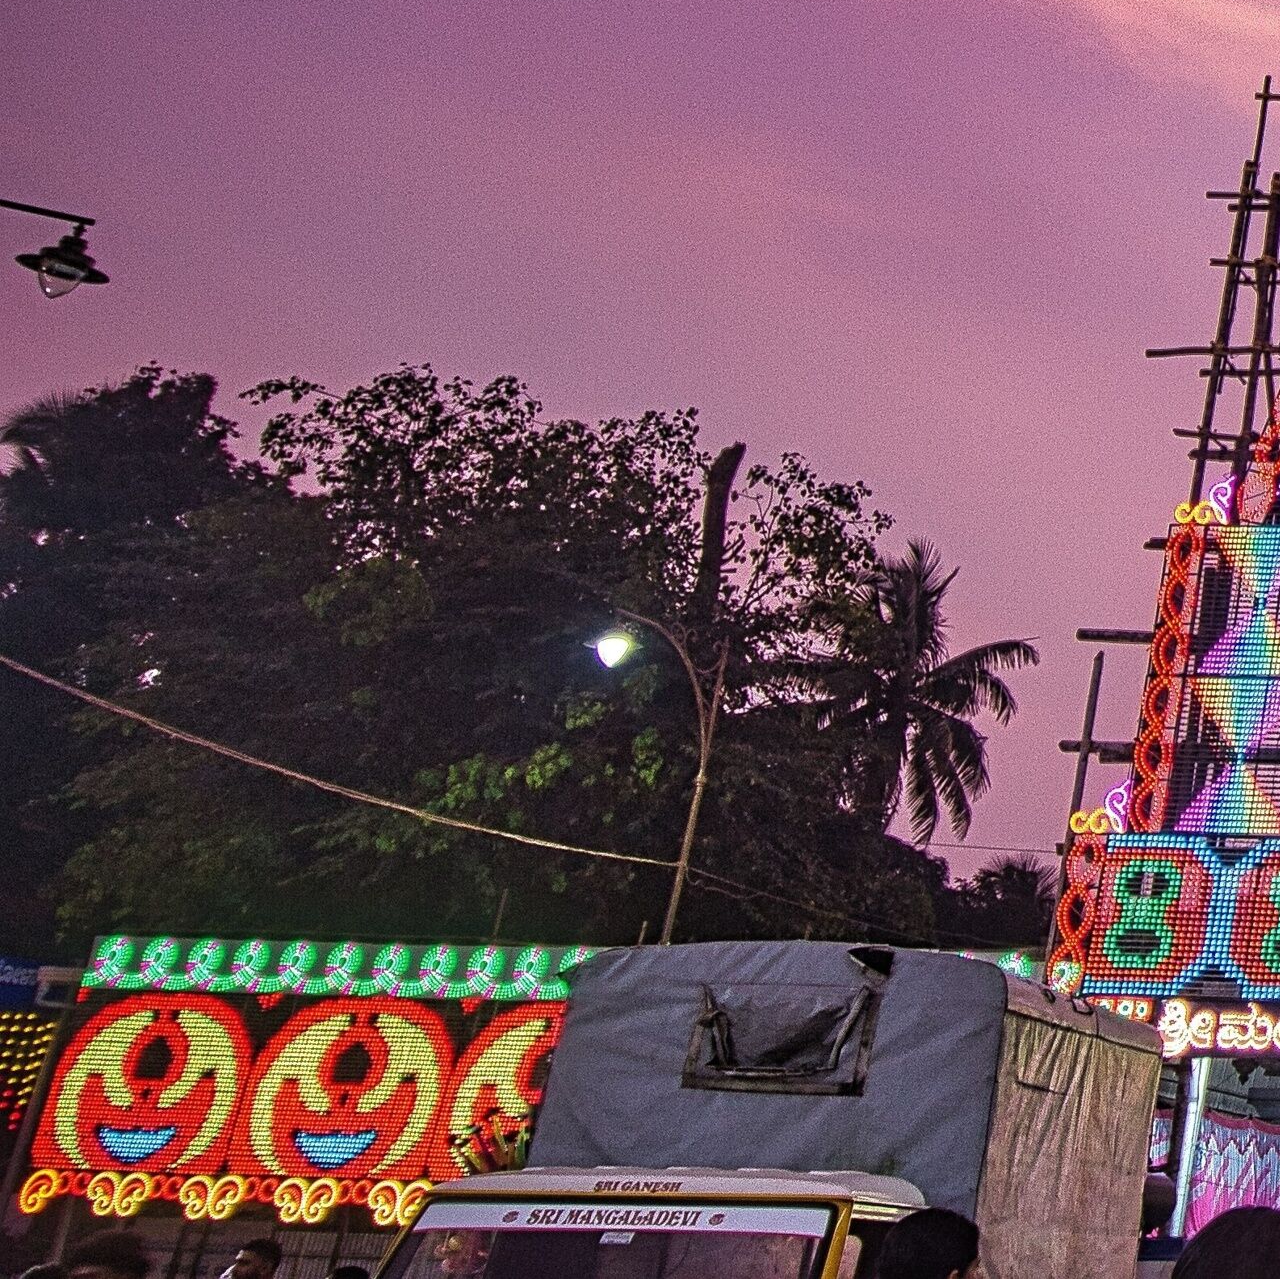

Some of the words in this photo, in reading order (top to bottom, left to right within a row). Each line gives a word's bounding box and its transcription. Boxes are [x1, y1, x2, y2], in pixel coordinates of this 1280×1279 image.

[594, 1181, 621, 1193] SRI
[620, 1181, 683, 1194] GANESH
[526, 1209, 565, 1225] SRI
[561, 1209, 703, 1227] MANGALADEVI
